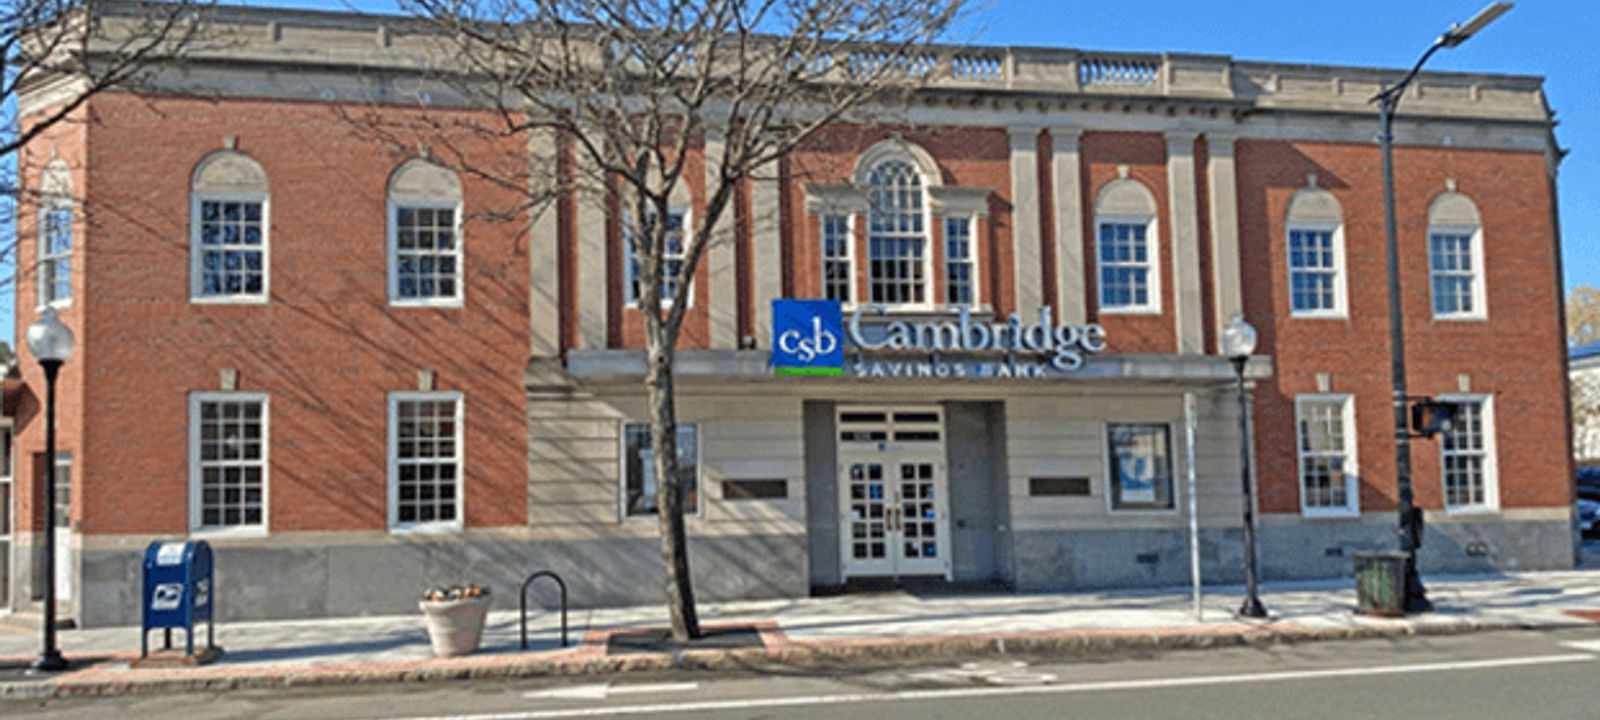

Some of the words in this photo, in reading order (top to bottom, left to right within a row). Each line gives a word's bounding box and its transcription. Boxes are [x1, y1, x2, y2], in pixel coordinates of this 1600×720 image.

[779, 316, 837, 362] csb
[850, 305, 1106, 370] Cambridge
[853, 362, 967, 378] SAVINGS
[977, 362, 1047, 378] BANK
